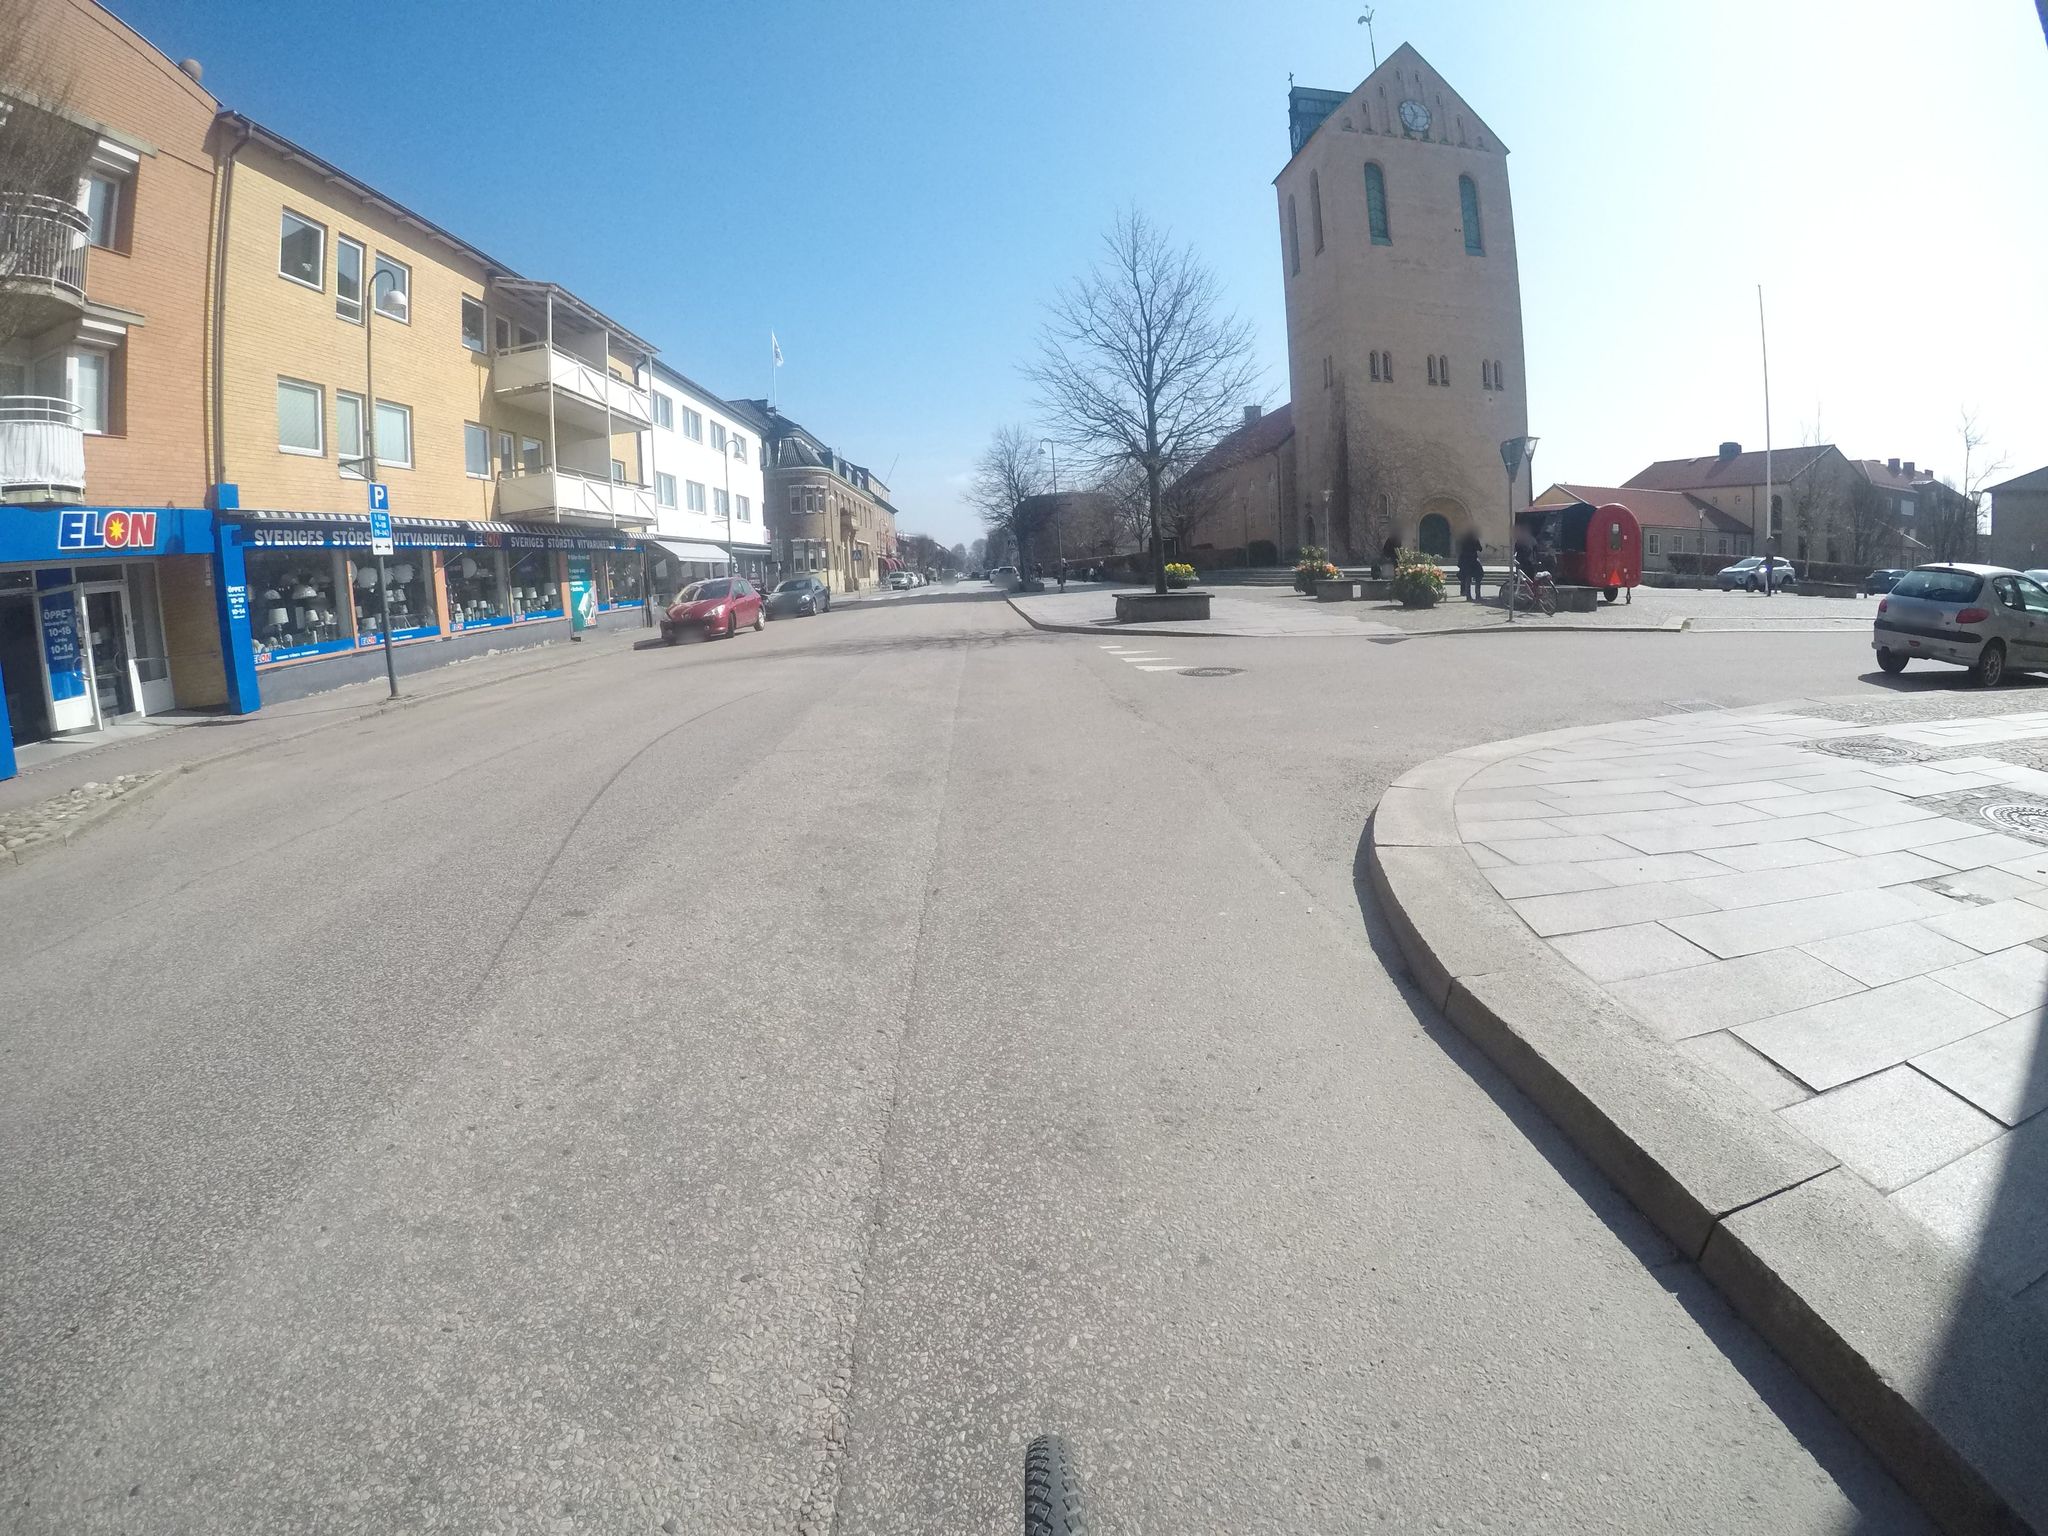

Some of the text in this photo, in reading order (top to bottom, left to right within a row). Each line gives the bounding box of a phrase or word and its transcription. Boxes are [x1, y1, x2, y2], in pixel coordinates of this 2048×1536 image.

[374, 486, 385, 508] P
[58, 511, 156, 549] ELON
[254, 527, 502, 547] SVERIGES STÖRS VITVARUKEDJA ELON
[511, 536, 544, 548] SVERIGES
[547, 535, 575, 549] STÖRSTA
[43, 609, 72, 620] ÖPPET
[49, 626, 71, 637] 10-18
[51, 643, 74, 654] 10-14
